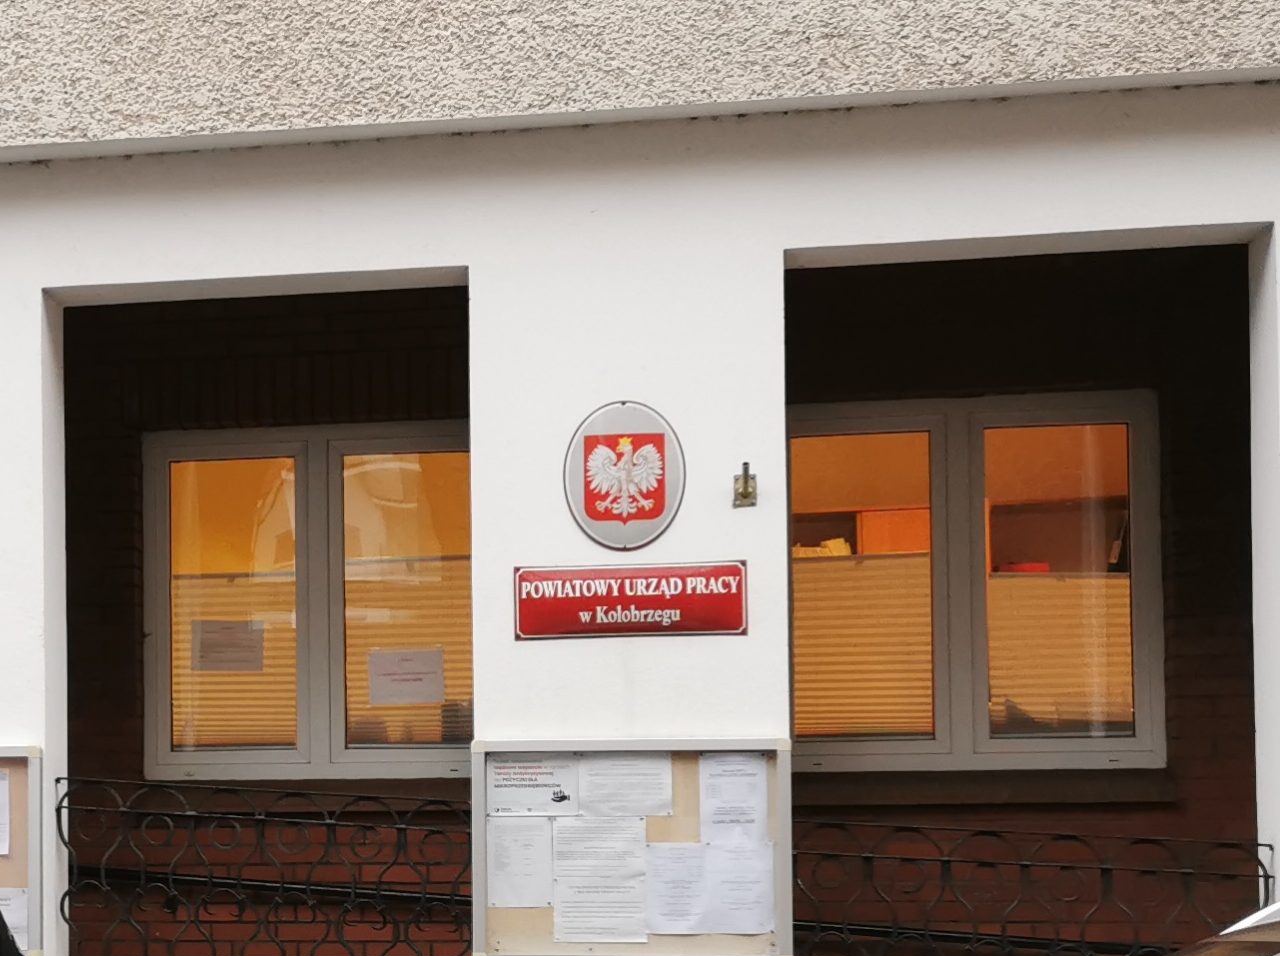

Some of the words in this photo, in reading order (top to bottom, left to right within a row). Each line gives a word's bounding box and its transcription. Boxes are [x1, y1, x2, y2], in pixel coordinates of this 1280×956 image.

[521, 578, 621, 599] POWIATOWY
[625, 577, 682, 598] URZĄD
[686, 576, 740, 595] PRACY
[579, 610, 592, 624] w
